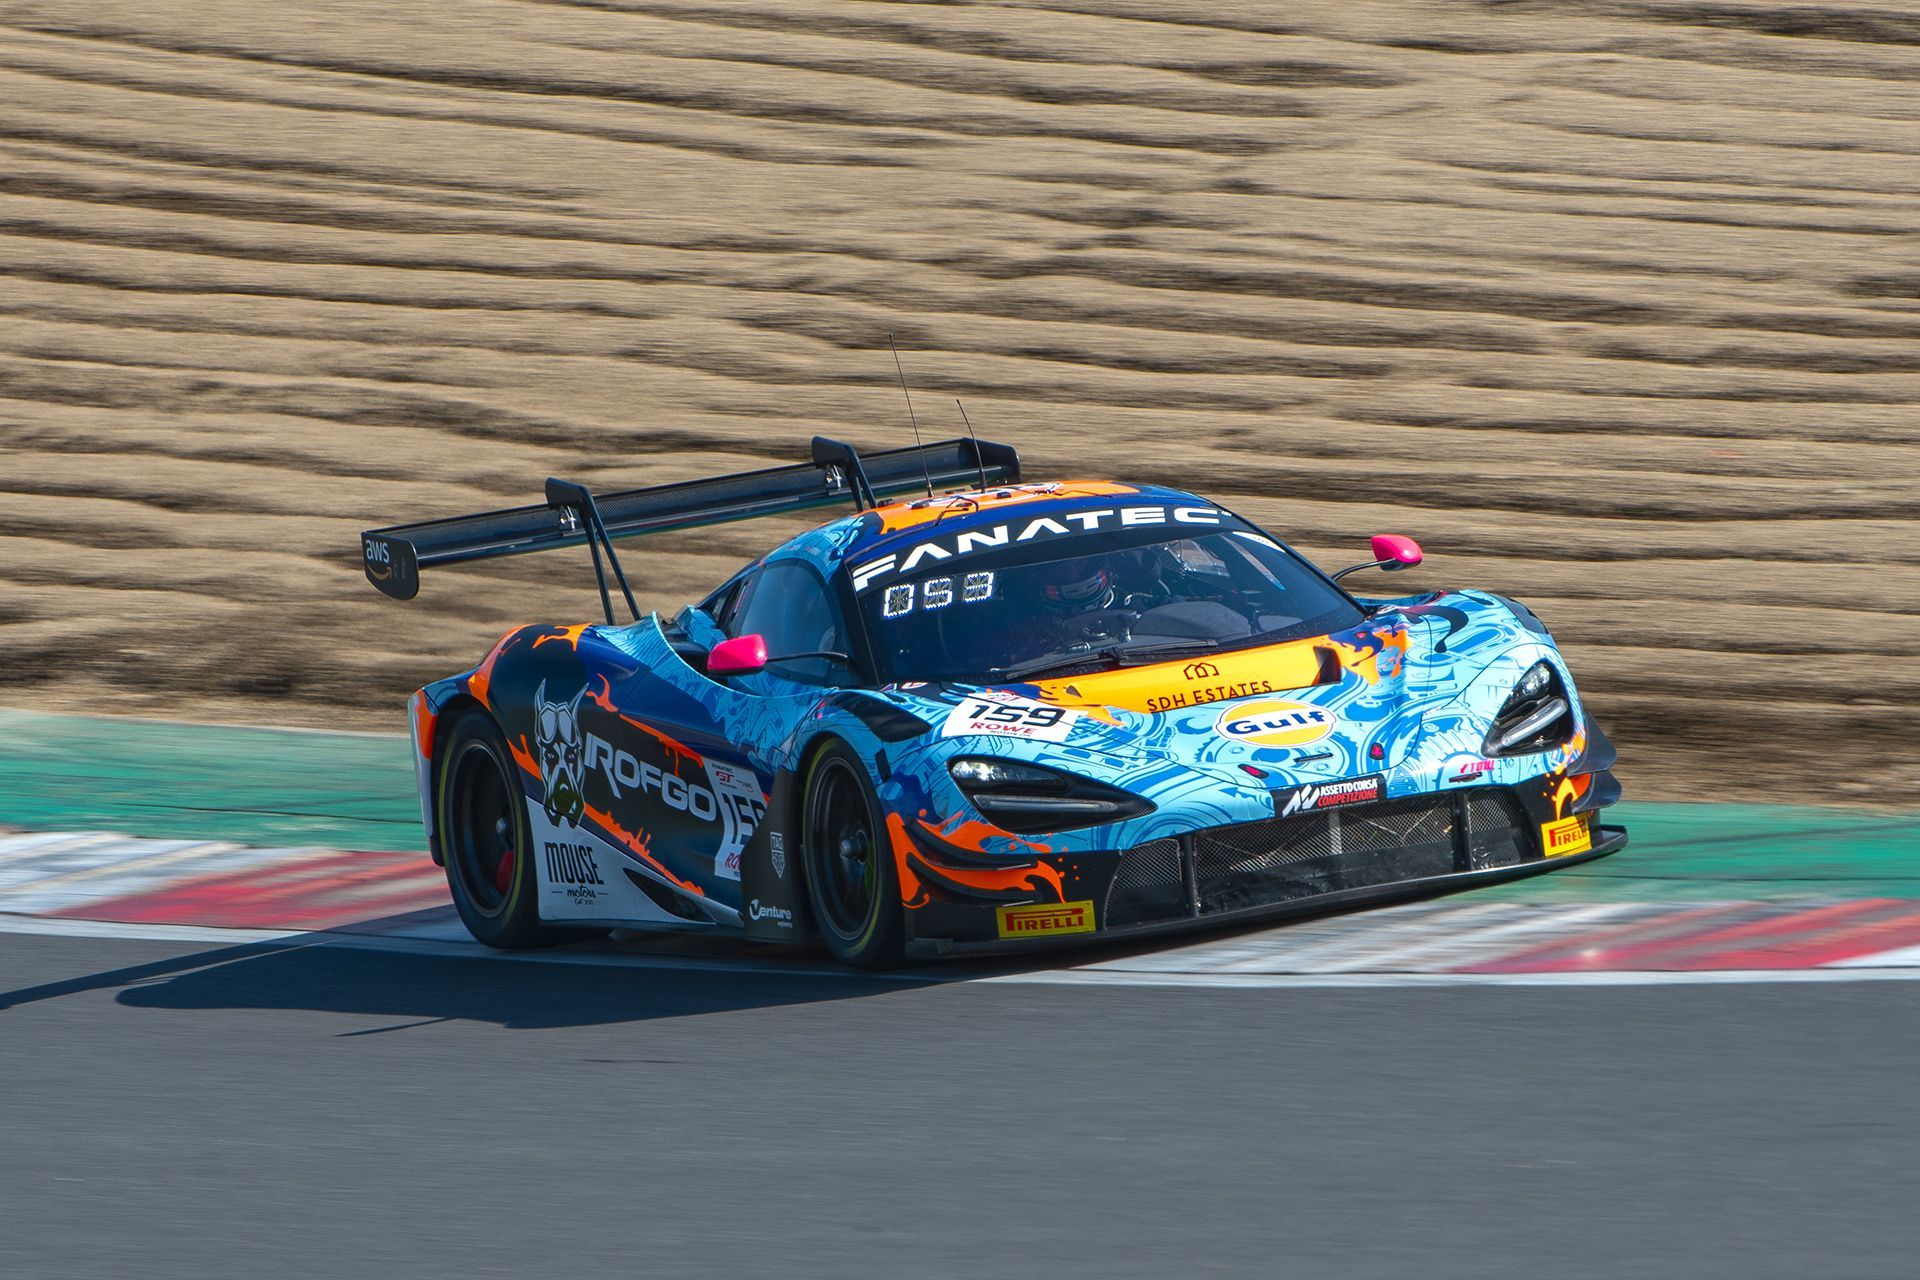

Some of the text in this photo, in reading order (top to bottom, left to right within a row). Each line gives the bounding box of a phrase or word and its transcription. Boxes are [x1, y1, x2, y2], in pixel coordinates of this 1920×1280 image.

[365, 540, 390, 563] aws
[853, 507, 1219, 592] FANATEC
[1147, 680, 1273, 711] SDH ESTATES
[968, 705, 1067, 728] 159
[970, 721, 1037, 735] ROWE
[1226, 711, 1326, 735] Gulf
[584, 732, 718, 822] ROFGO
[715, 770, 735, 783] GT
[1320, 778, 1378, 796] ASSETTO CORSA
[1317, 789, 1378, 807] COMPETIZIONE
[544, 842, 605, 885] MOUSE
[567, 885, 597, 899] motors
[750, 899, 792, 920] Venture
[1005, 907, 1085, 932] PIRELLI
